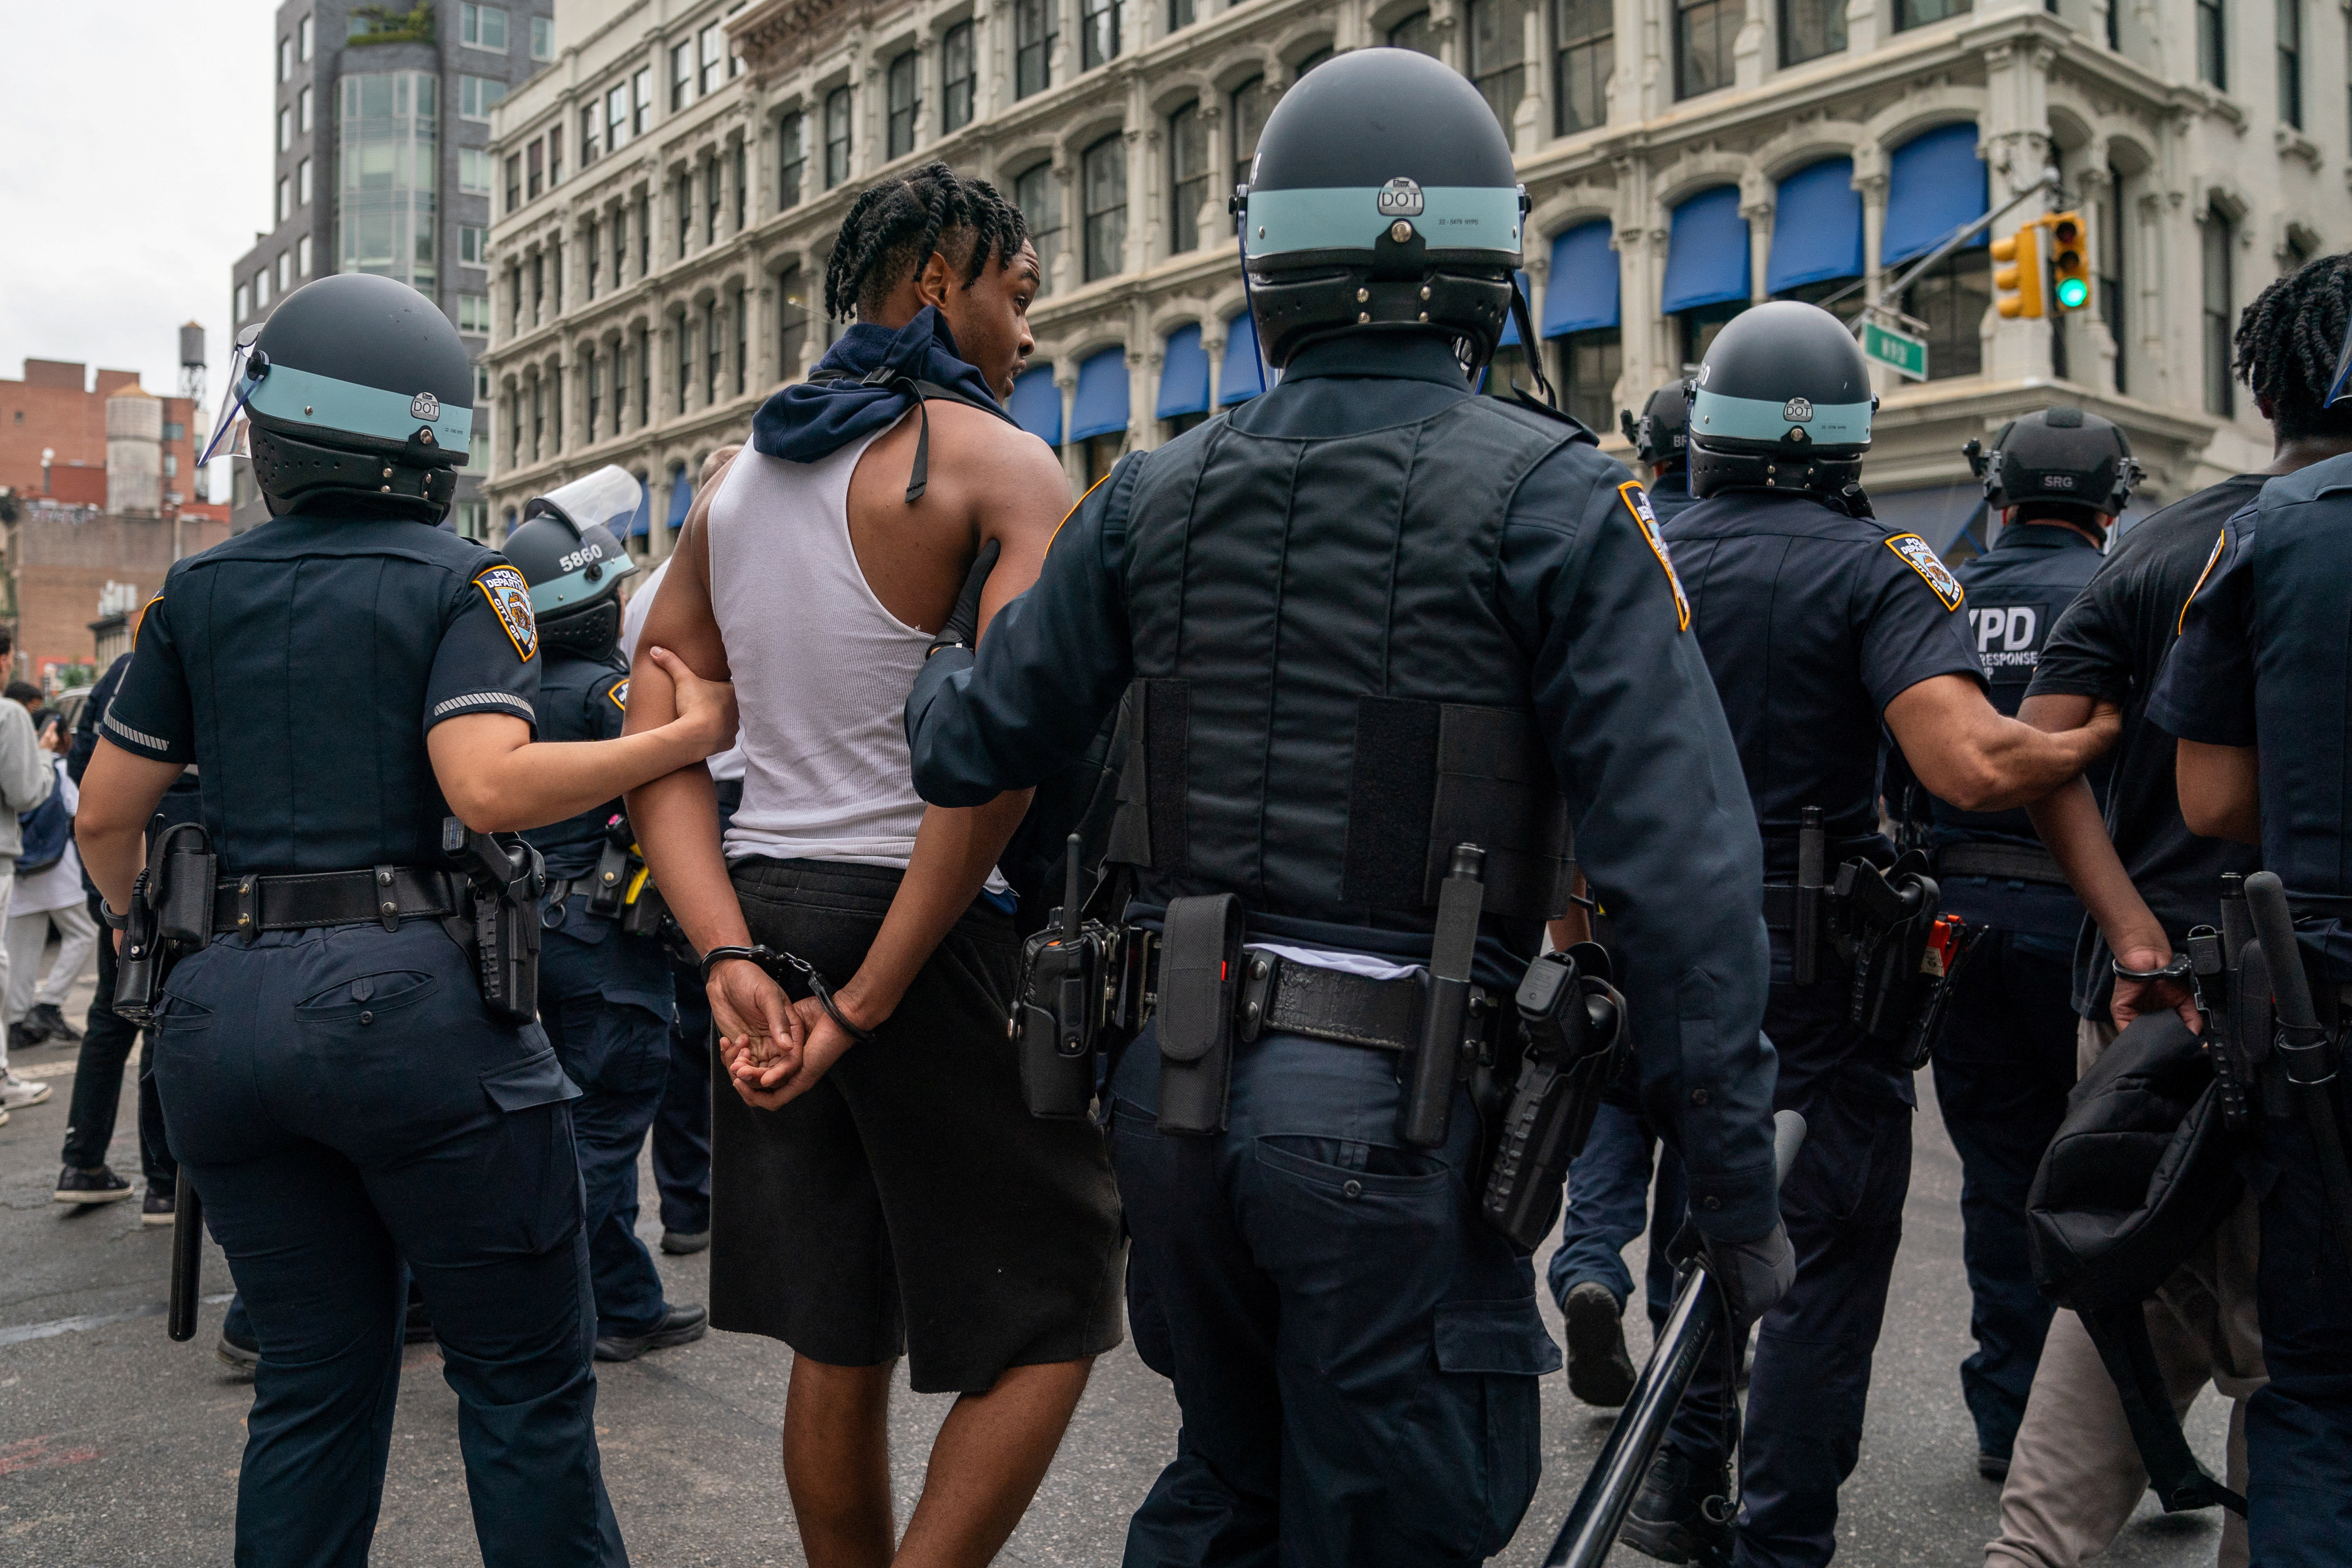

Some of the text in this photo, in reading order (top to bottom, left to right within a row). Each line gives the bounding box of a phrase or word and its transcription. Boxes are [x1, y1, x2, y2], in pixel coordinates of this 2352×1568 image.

[1382, 192, 1420, 207] DOT
[414, 401, 438, 415] DOT
[1787, 406, 1811, 416] DOT
[2044, 475, 2073, 487] SRG
[559, 544, 603, 572] 5860
[1912, 560, 1943, 593] CITY OF
[494, 598, 520, 640] CITY OF
